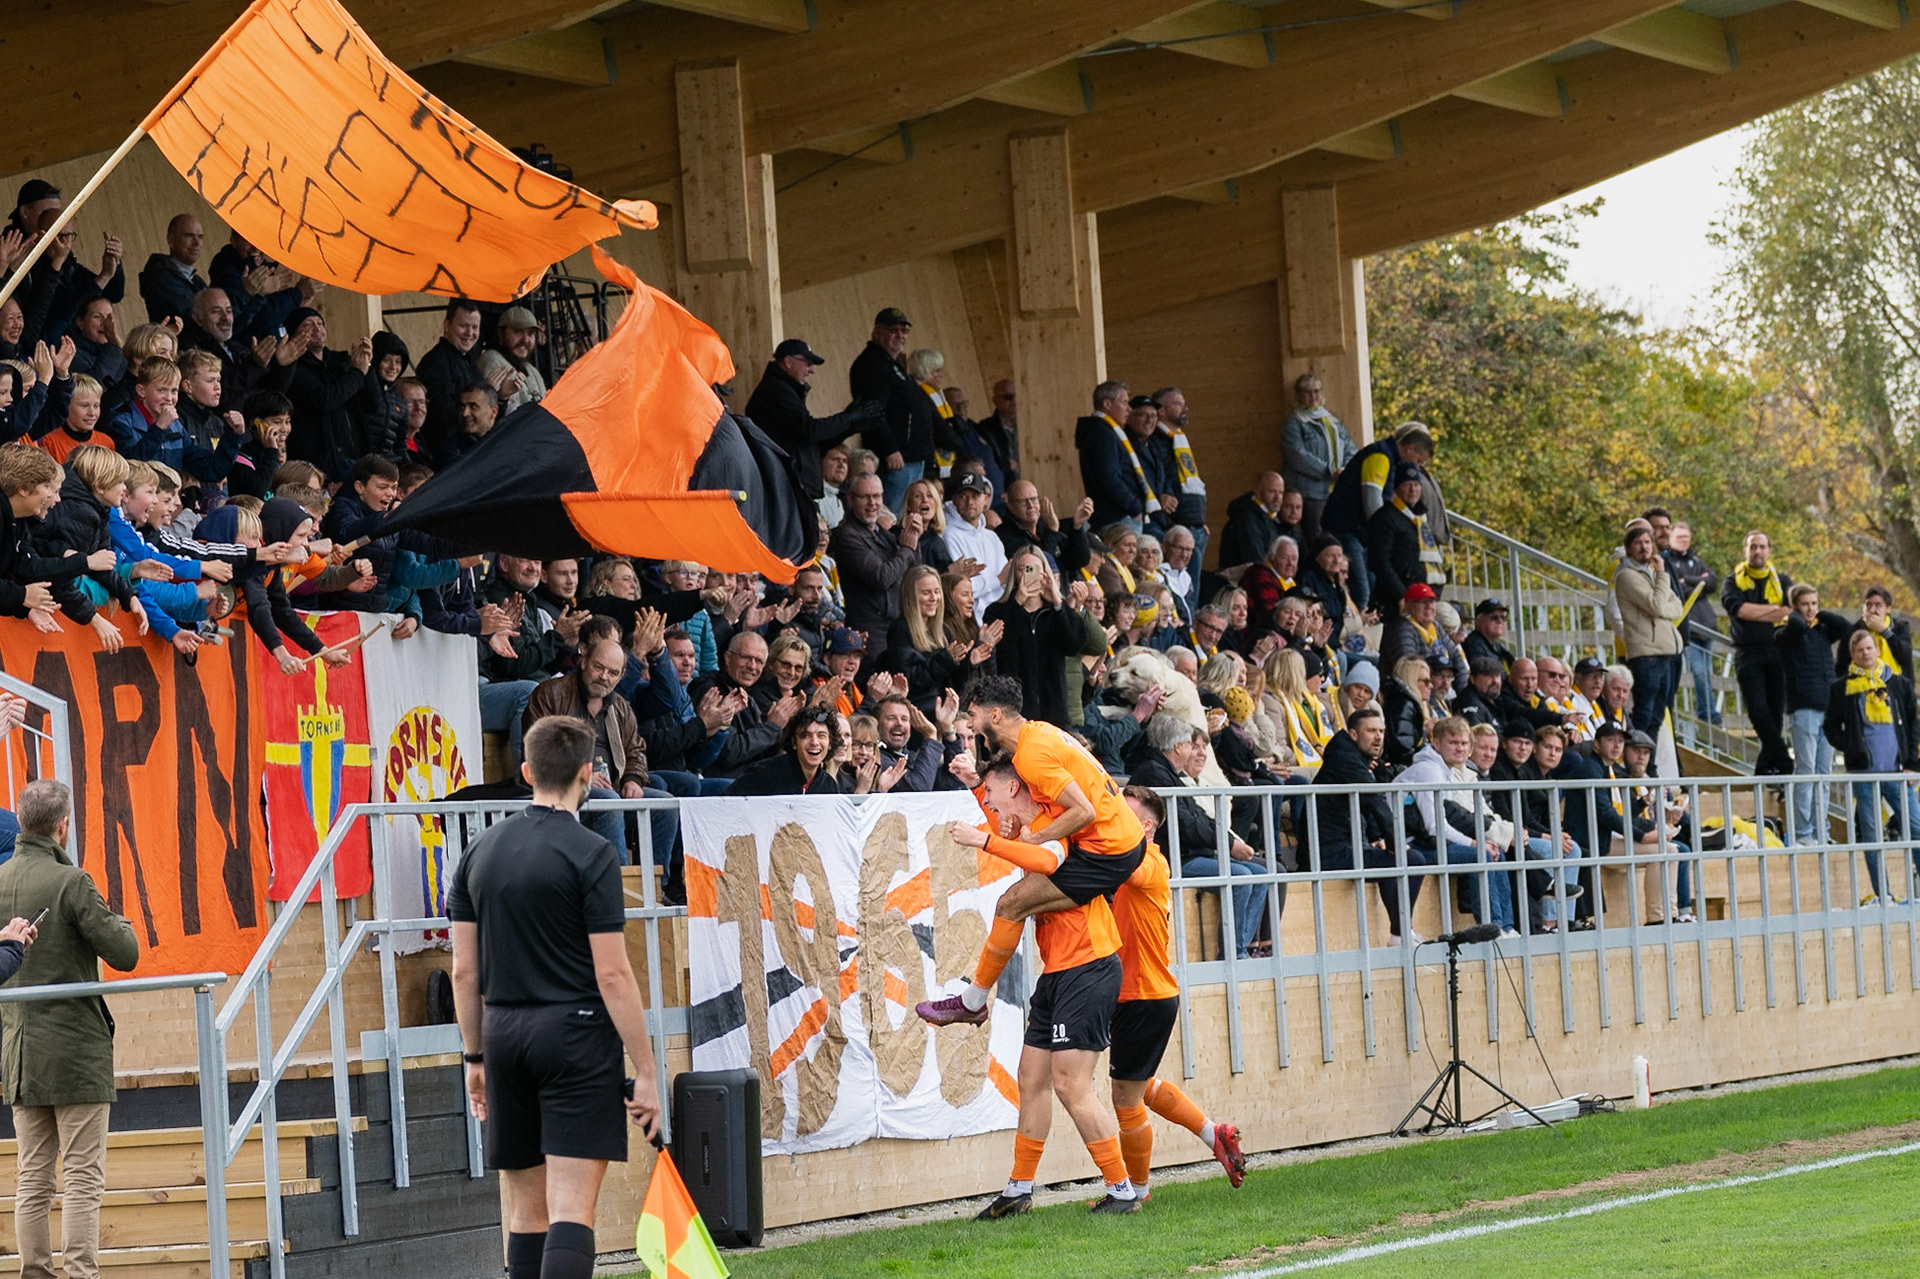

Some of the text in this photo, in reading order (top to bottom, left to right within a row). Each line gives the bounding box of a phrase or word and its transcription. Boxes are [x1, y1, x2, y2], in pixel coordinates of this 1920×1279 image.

[325, 109, 504, 242] ETT
[300, 720, 333, 739] TORNS
[716, 811, 996, 1141] 1965
[1052, 1023, 1066, 1038] 20
